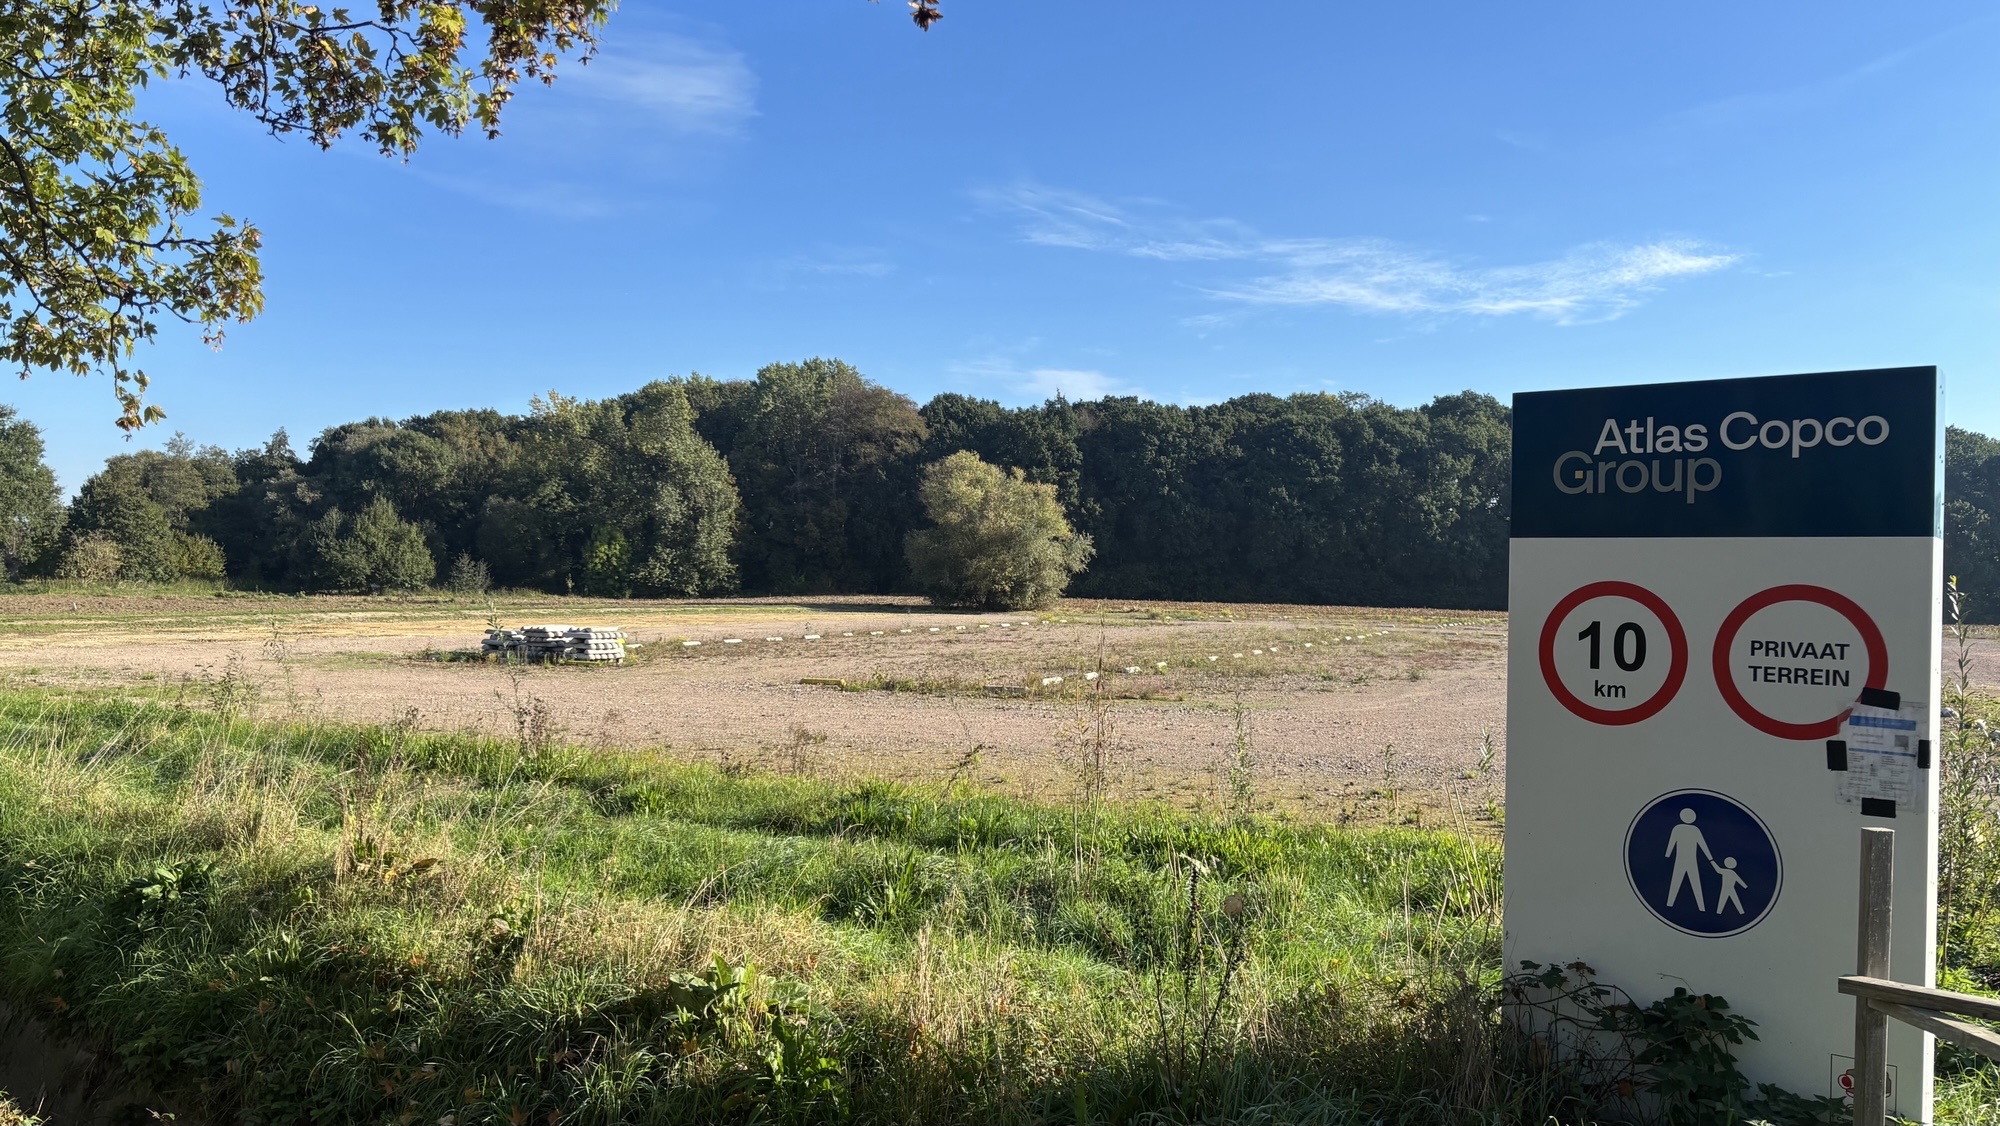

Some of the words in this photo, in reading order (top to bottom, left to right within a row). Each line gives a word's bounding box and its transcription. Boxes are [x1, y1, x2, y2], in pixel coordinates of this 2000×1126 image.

[1593, 416, 1709, 456] Atlas
[1719, 411, 1890, 458] Copco
[1552, 450, 1723, 504] Group
[1578, 620, 1647, 672] 10
[1750, 640, 1850, 661] PRIVAAT
[1593, 680, 1626, 699] km
[1748, 665, 1850, 687] TERREIN
